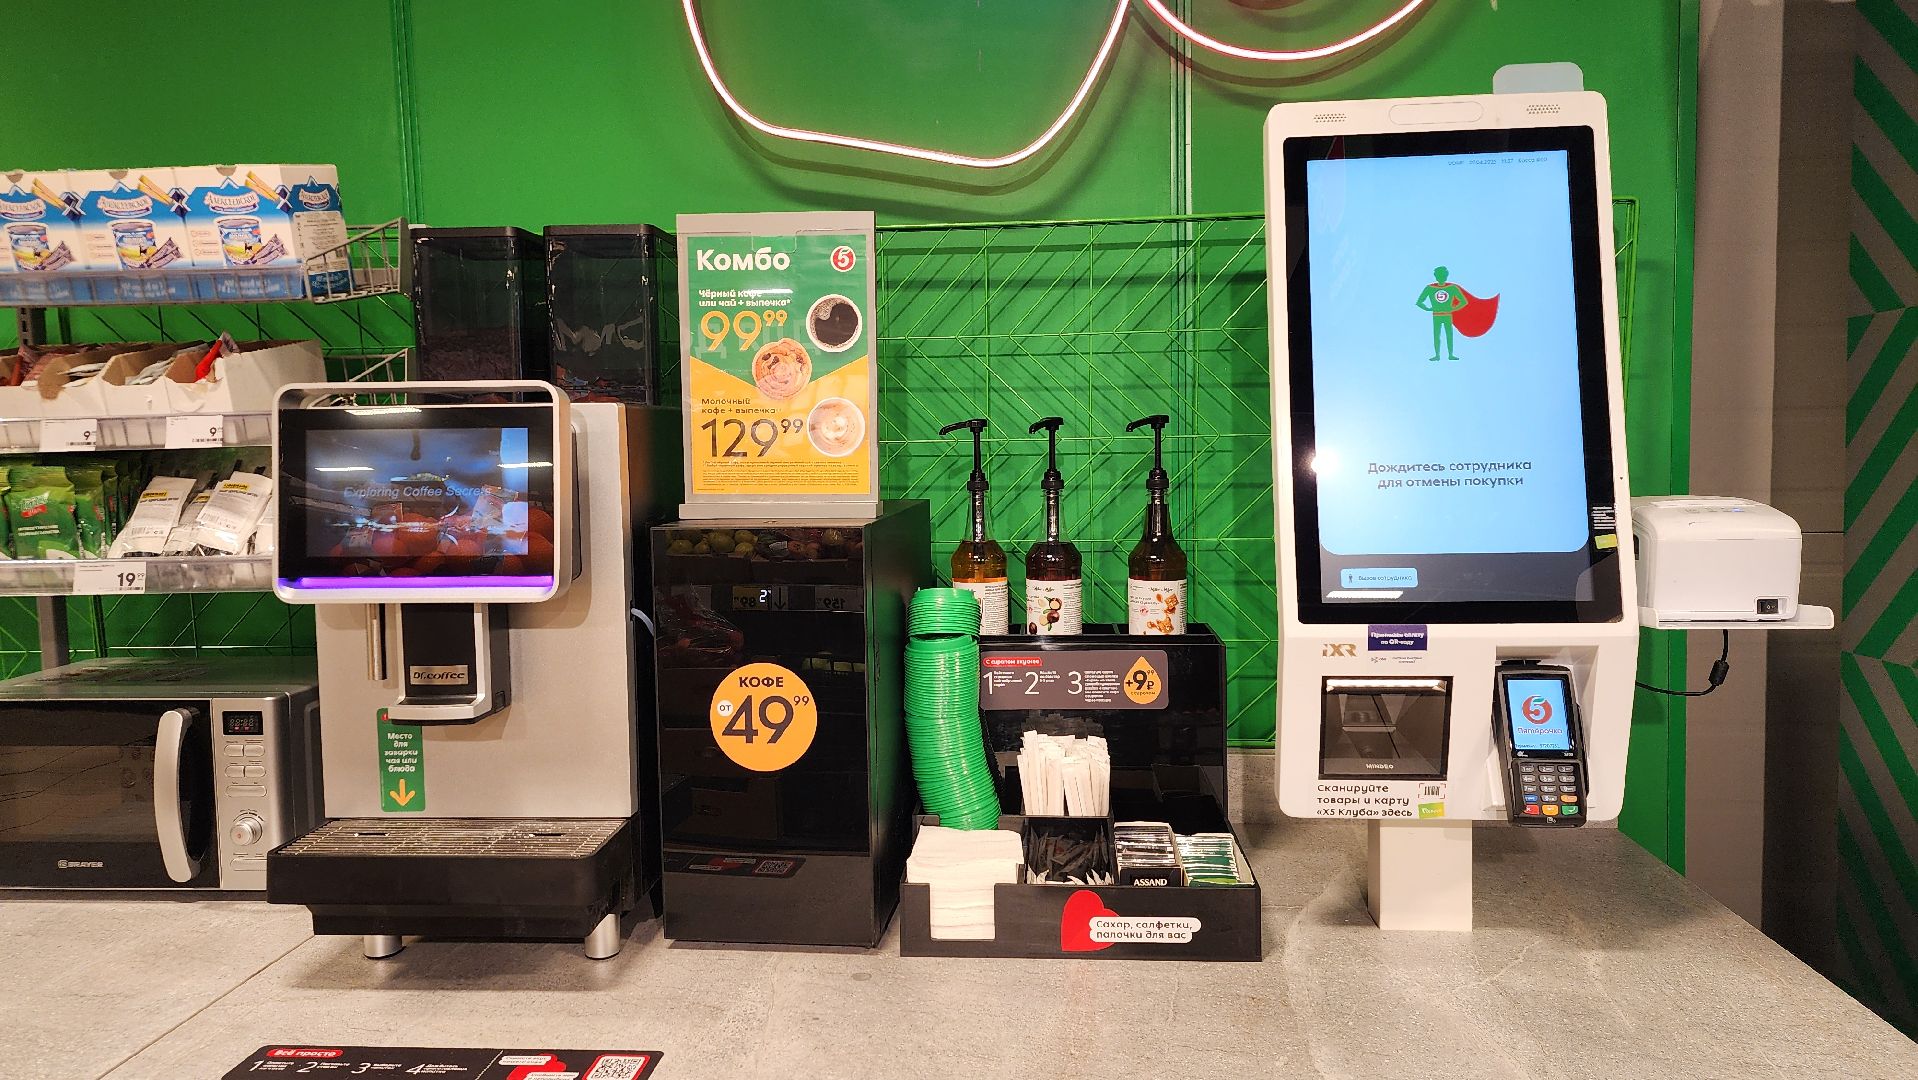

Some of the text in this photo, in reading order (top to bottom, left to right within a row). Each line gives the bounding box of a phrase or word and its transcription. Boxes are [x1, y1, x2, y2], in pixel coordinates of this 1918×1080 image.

[696, 247, 791, 271] Комбо
[699, 289, 737, 299] Чёрный
[699, 299, 717, 307] или
[718, 298, 737, 307] чай
[701, 309, 788, 351] 99 99
[701, 397, 751, 405] Молочный
[701, 407, 726, 415] кофе
[209, 426, 217, 437] 9
[701, 418, 804, 458] 129 99
[1367, 460, 1532, 475] Дождитесь сотрудника
[1378, 476, 1524, 489] для отмены покупки
[343, 485, 491, 499] Exploring Coffee Secrets
[117, 572, 136, 586] 19
[413, 671, 466, 680] Dr.coffee
[738, 676, 784, 688] КОФЕ
[983, 671, 993, 695] 1
[1024, 671, 1040, 695] 2
[1067, 671, 1083, 695] 3
[721, 695, 810, 744] 49 99
[387, 732, 413, 740] Место
[393, 740, 409, 748] для
[384, 749, 418, 757] заварки
[388, 764, 416, 773] блюда
[1317, 784, 1389, 794] Сканируйте
[1317, 797, 1360, 805] товары
[1374, 797, 1410, 806] карту
[1338, 808, 1379, 818] Клуба»
[1381, 809, 1413, 817] здесь
[1133, 878, 1168, 887] ASSAND
[1096, 920, 1193, 931] Сахар, салфетки,
[1096, 931, 1143, 941] палочки
[1145, 930, 1164, 940] для
[249, 1060, 264, 1072] 1
[296, 1061, 318, 1073] 2
[351, 1062, 371, 1074] 3
[405, 1063, 426, 1075] 4
